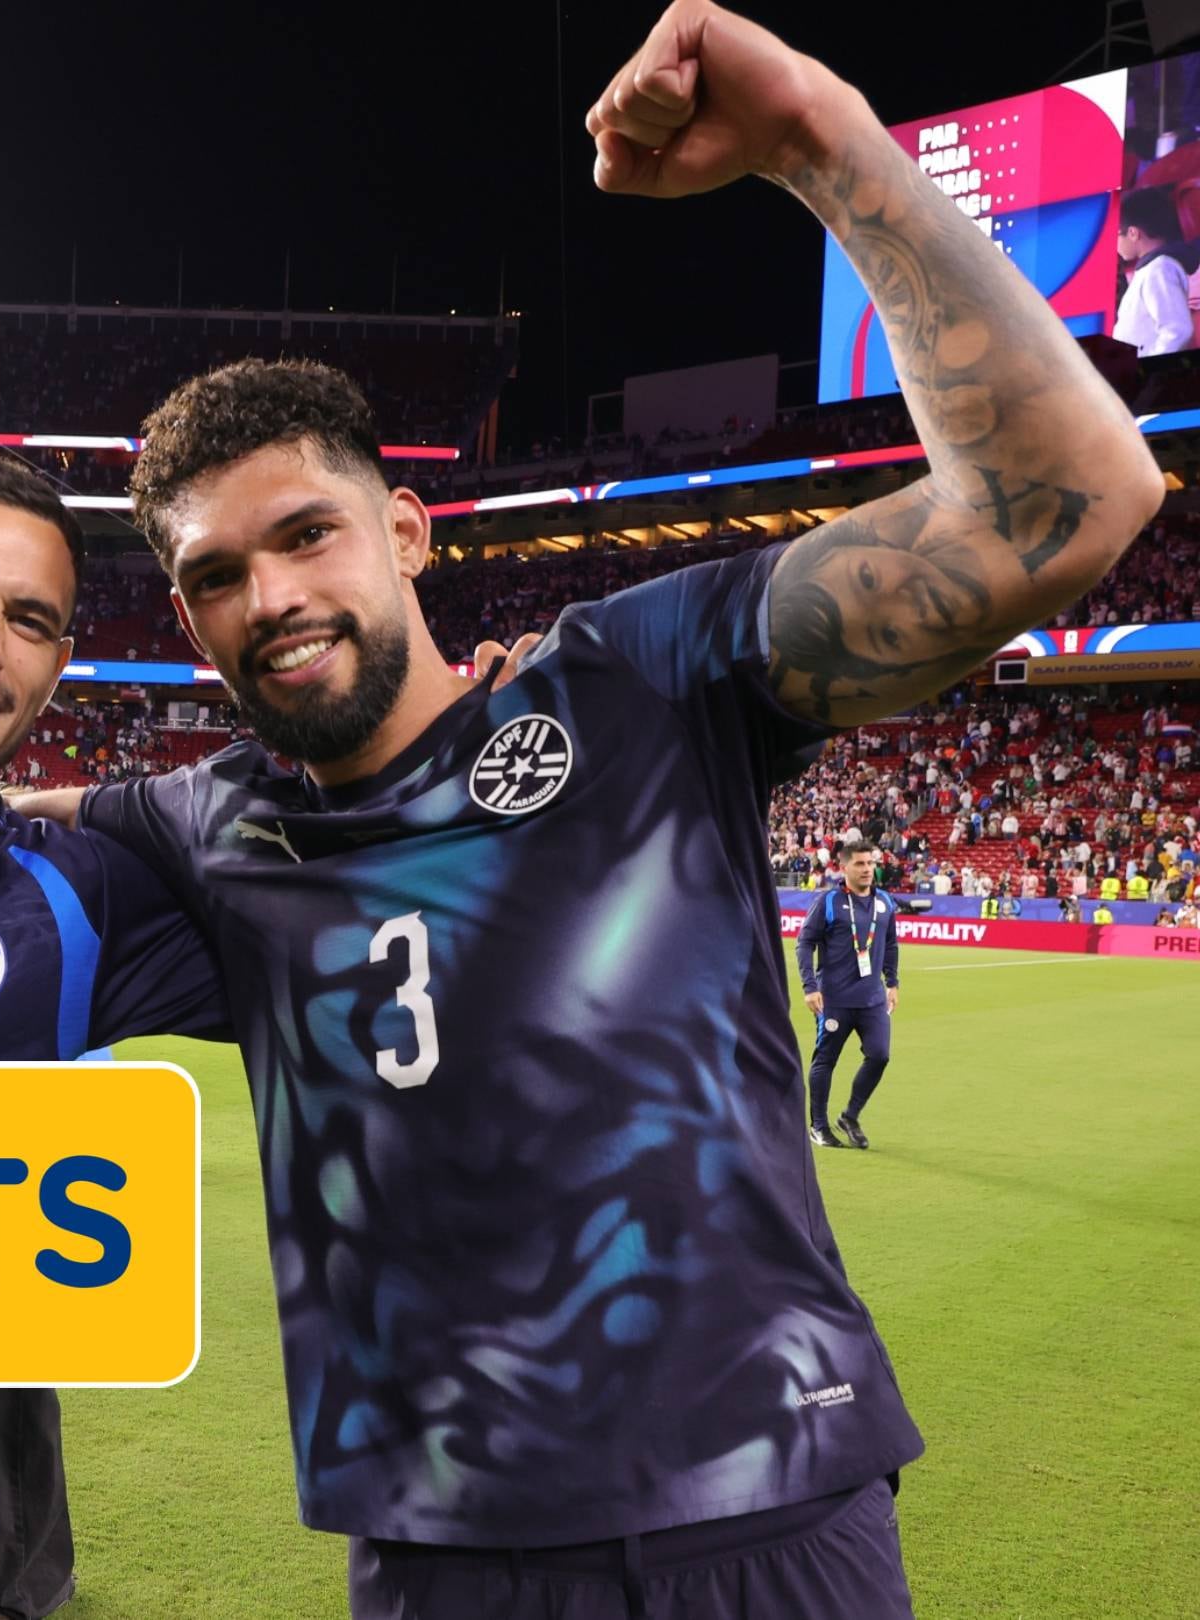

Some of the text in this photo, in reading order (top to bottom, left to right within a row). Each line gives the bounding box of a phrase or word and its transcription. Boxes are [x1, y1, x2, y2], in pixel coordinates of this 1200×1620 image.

[494, 724, 523, 758] APF
[508, 778, 557, 809] PARAGUAY
[1154, 935, 1200, 953] PRE
[369, 910, 440, 1090] 3
